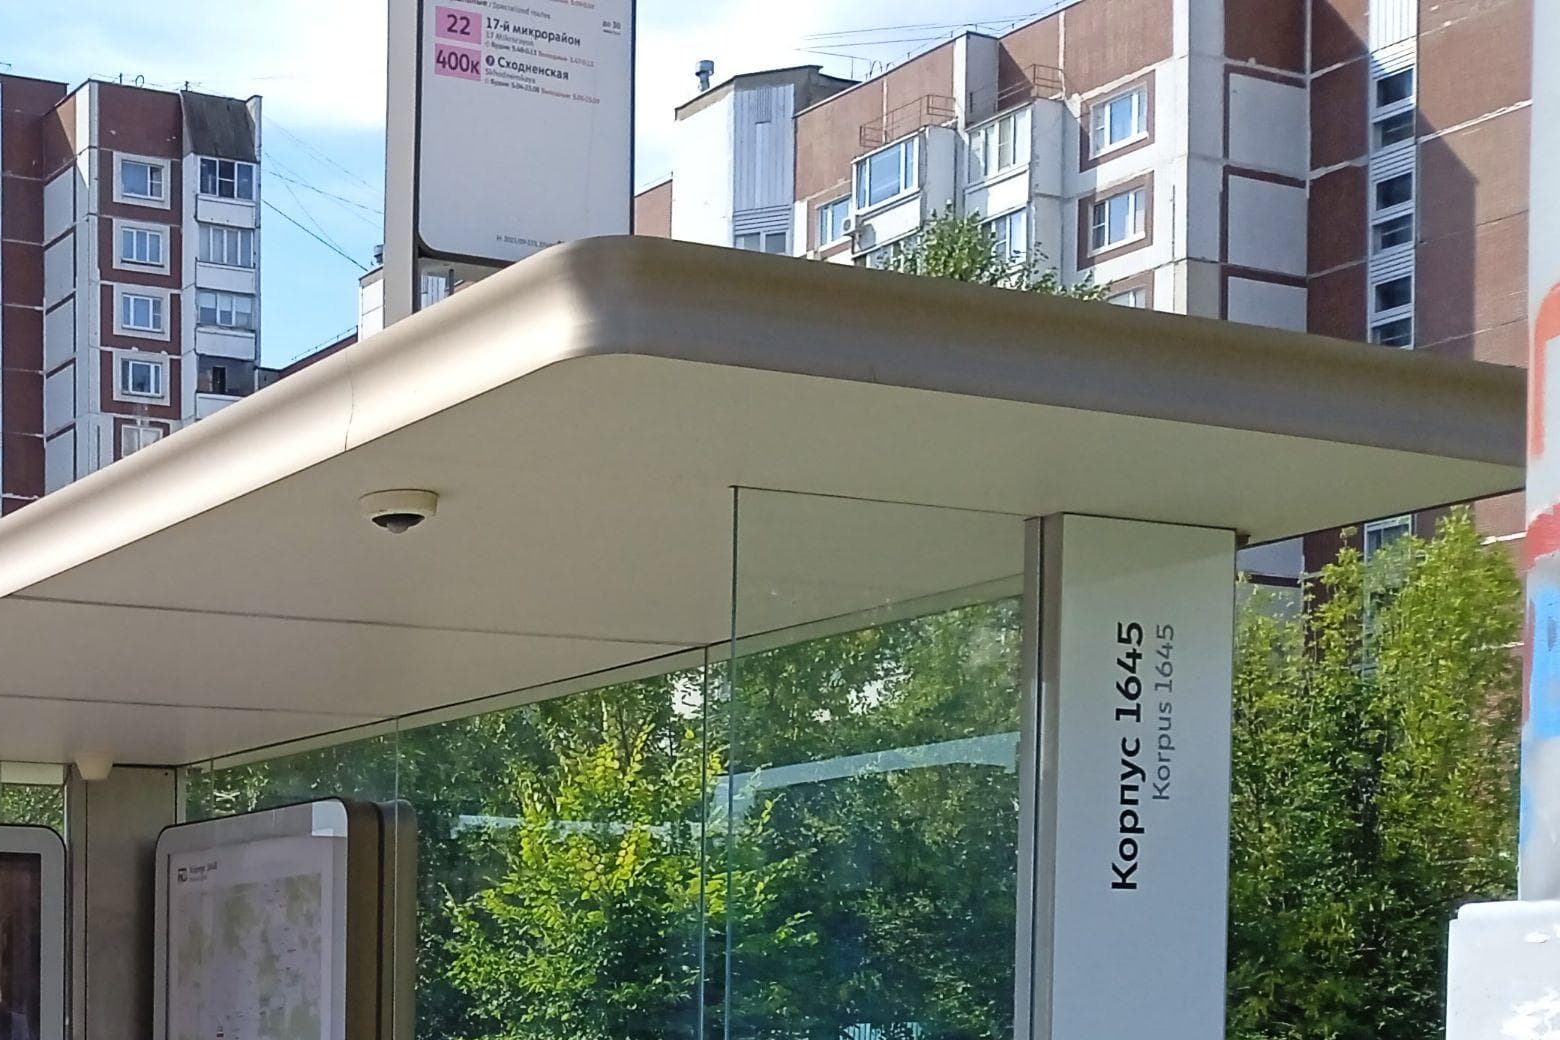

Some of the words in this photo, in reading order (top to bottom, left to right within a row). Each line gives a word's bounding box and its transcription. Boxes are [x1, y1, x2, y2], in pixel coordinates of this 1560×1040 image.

[446, 14, 471, 36] 22
[486, 17, 510, 33] 17-й
[512, 25, 582, 47] микрорайон
[435, 50, 482, 76] 400к
[497, 57, 570, 80] Сходненская
[1115, 621, 1145, 723] 1645
[1154, 623, 1175, 694] 1645
[1152, 701, 1176, 800] Korpus
[1111, 736, 1147, 890] Корпус
